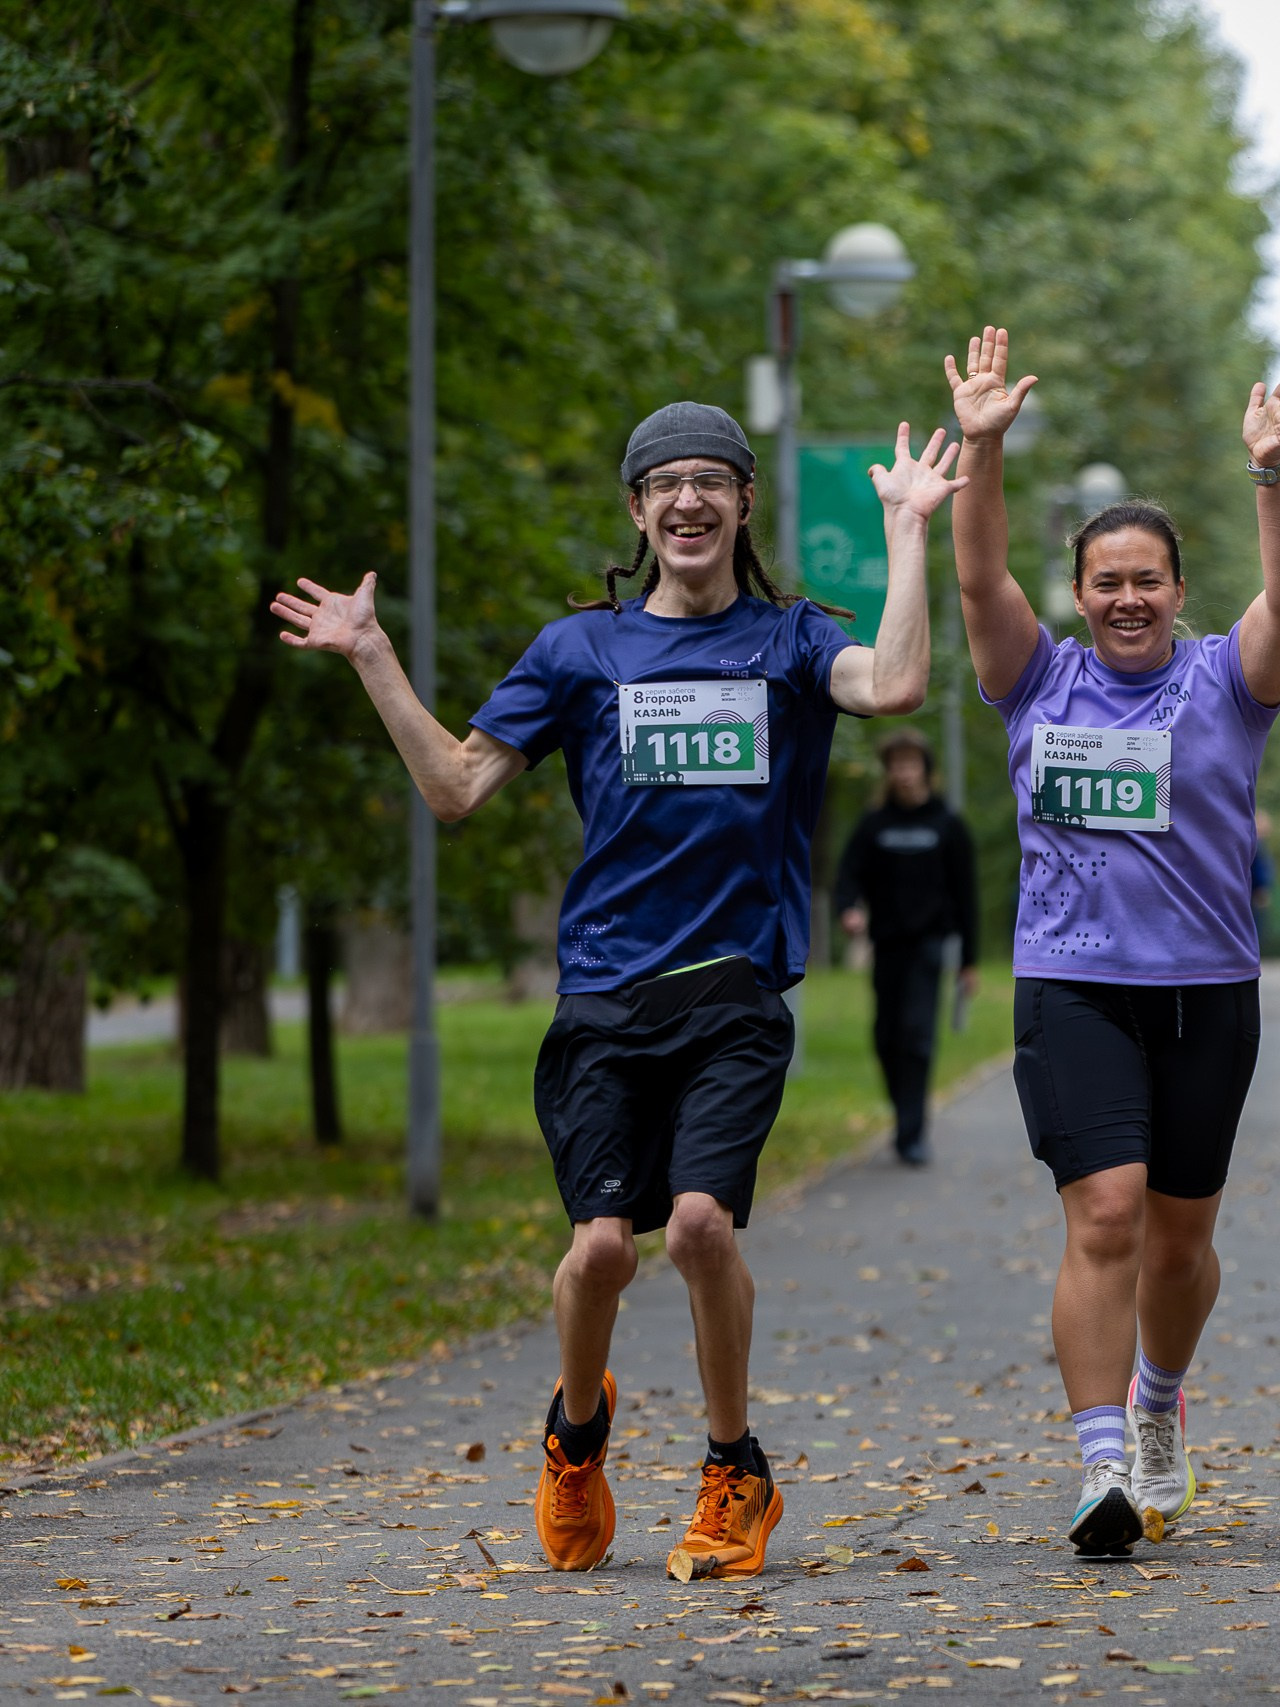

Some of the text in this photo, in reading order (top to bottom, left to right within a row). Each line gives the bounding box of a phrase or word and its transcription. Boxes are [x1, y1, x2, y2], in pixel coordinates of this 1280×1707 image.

[667, 687, 696, 695] забегов
[633, 691, 696, 706] 8 городов
[633, 708, 682, 718] КАЗАНЬ
[1045, 731, 1103, 750] 8 городов
[1076, 732, 1104, 740] забегов
[647, 731, 741, 765] 1118
[1044, 750, 1088, 761] КАЗАНЬ
[1055, 775, 1142, 812] 1119
